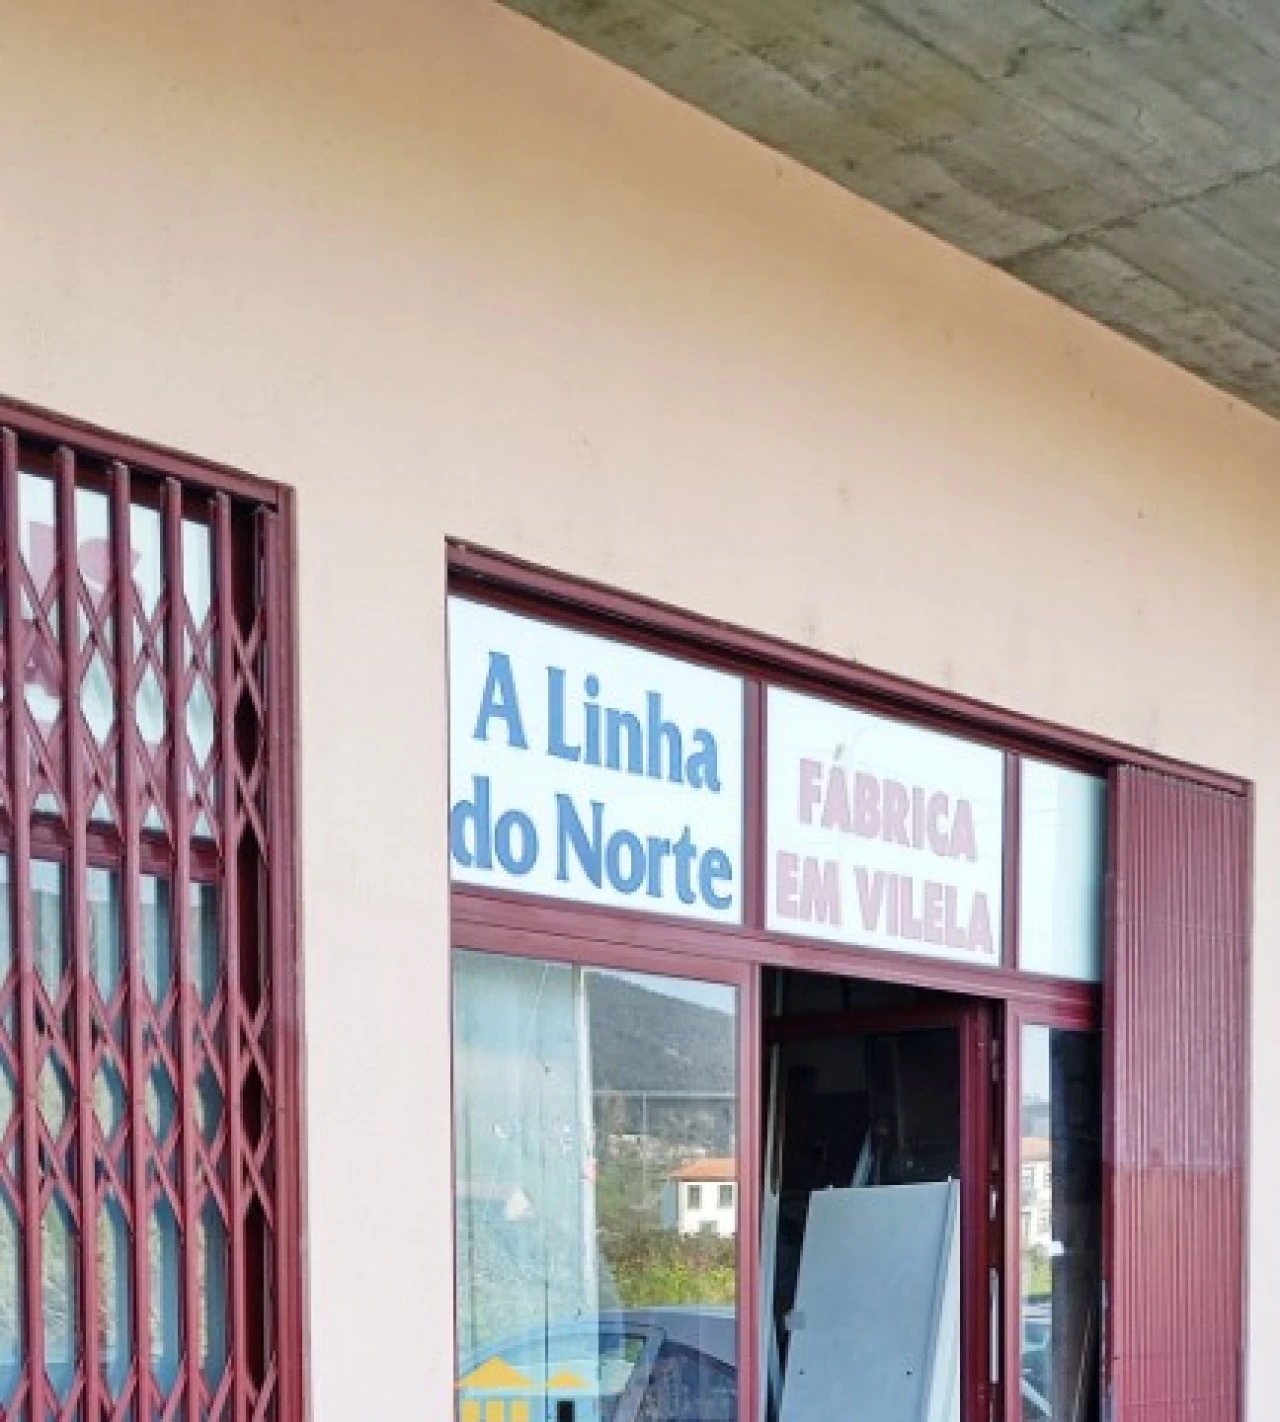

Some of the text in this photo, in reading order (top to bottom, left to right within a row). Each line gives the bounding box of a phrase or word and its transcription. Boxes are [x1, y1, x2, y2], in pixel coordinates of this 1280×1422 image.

[473, 650, 721, 792] A Linha
[450, 774, 732, 910] do Norte
[799, 744, 977, 862] FÁBRICA
[776, 850, 994, 954] EM VILELA
